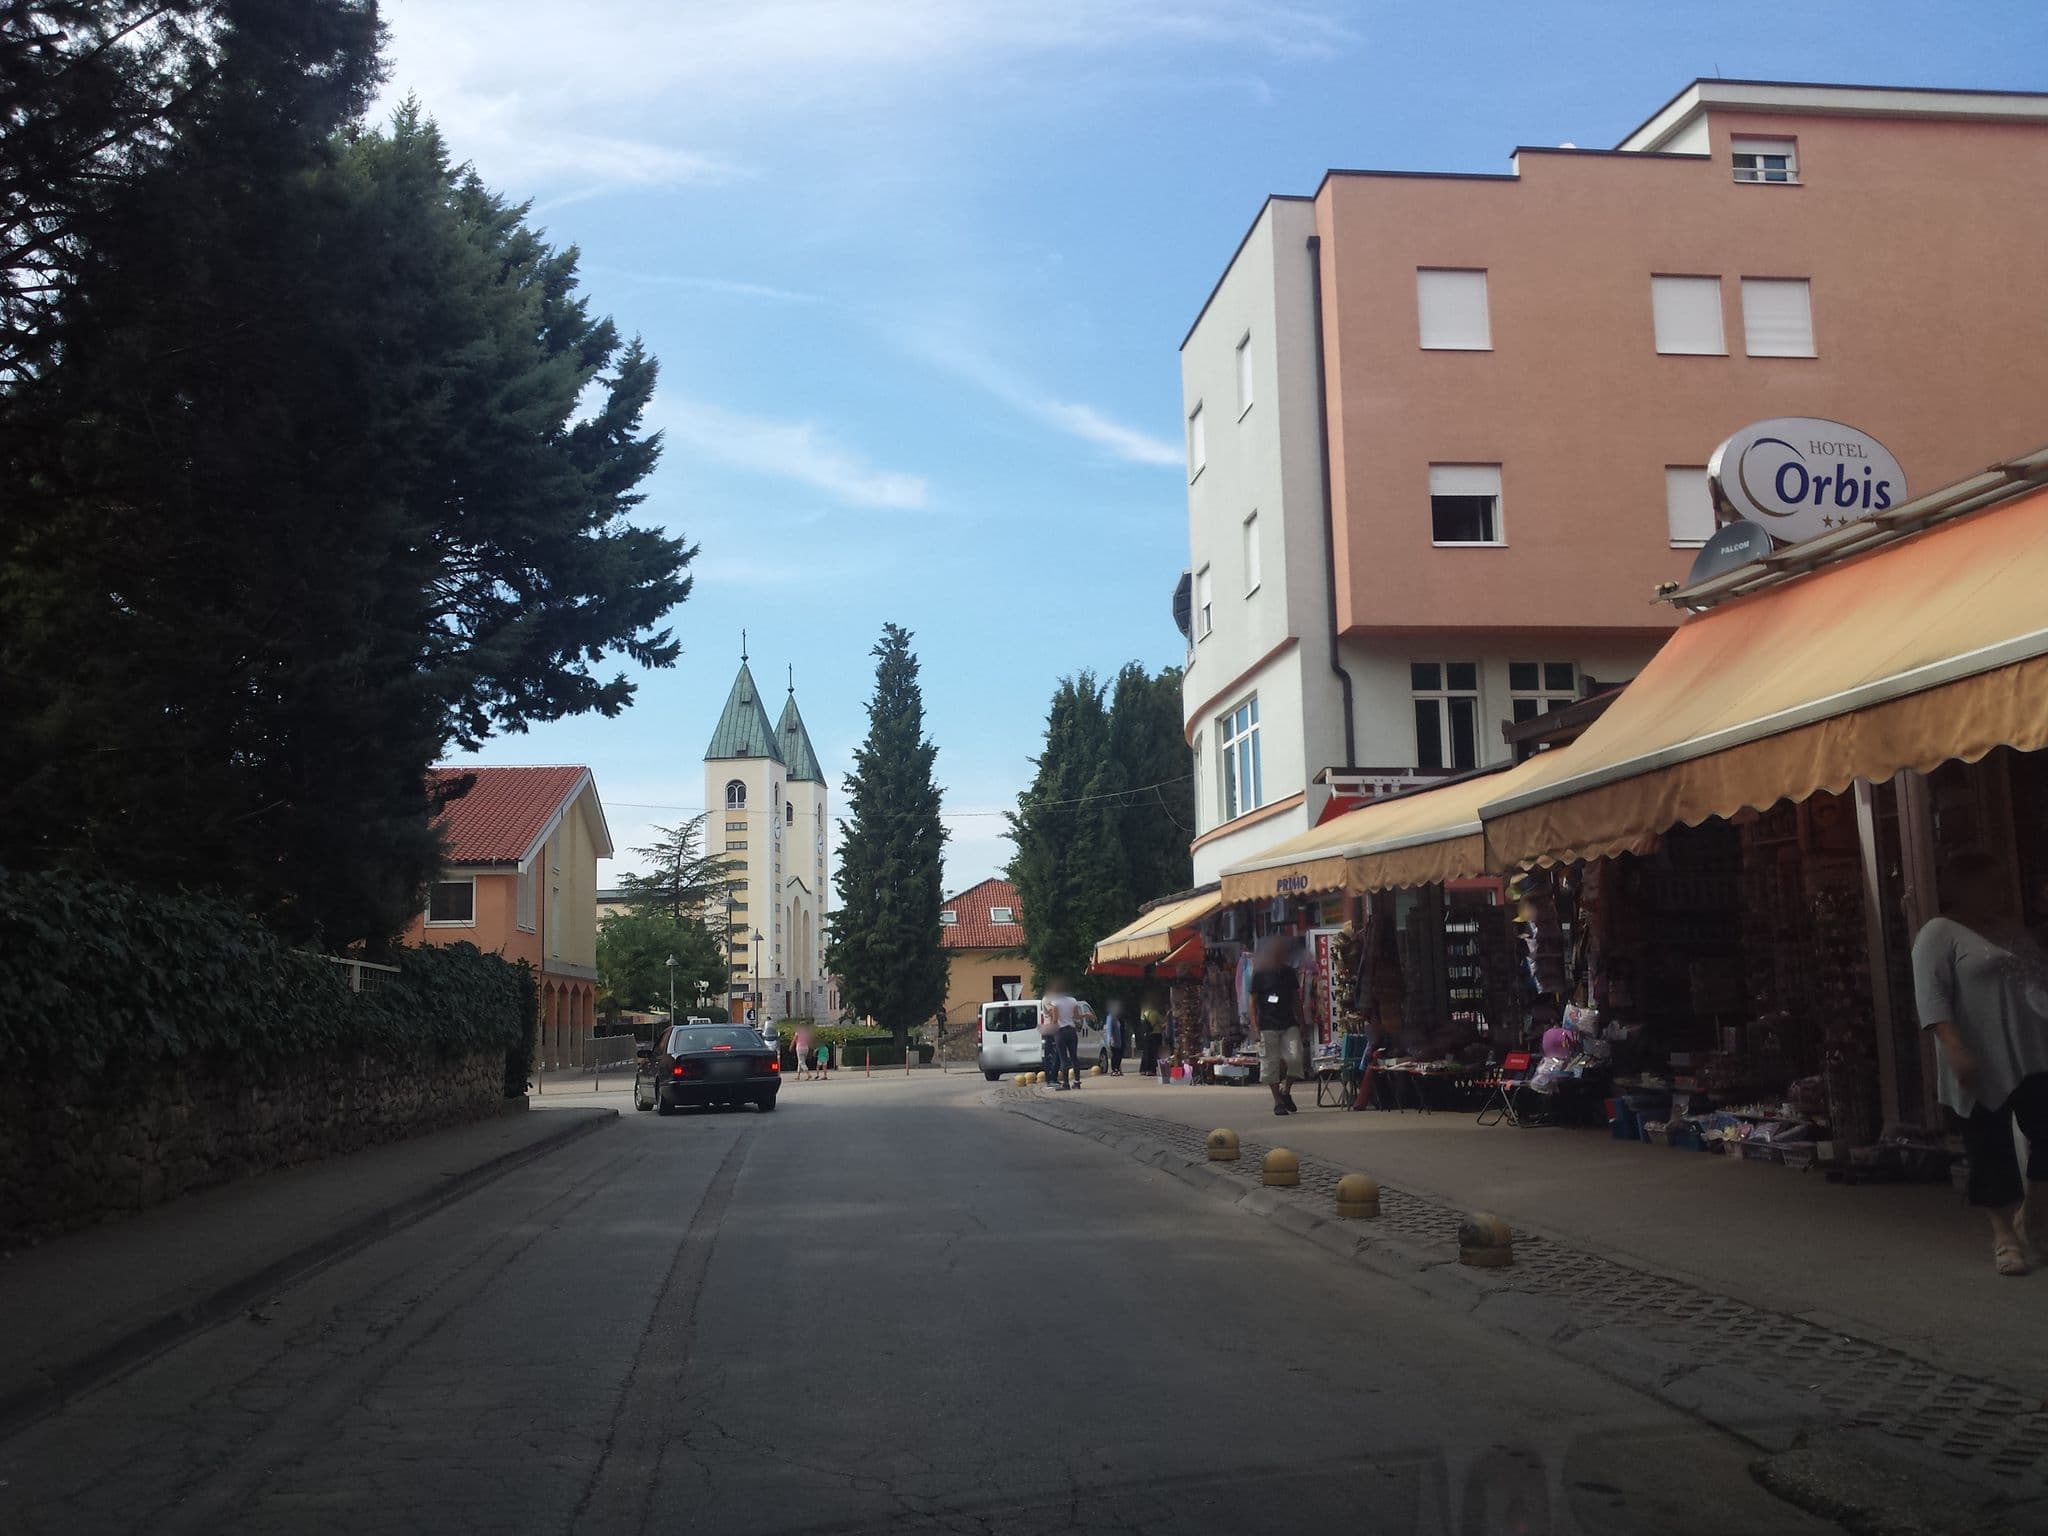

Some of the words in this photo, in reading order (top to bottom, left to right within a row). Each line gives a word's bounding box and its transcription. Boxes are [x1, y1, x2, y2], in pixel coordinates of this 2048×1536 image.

[1809, 440, 1868, 459] HOTEL
[1775, 461, 1892, 510] Orbis
[1276, 875, 1308, 892] PRIMO
